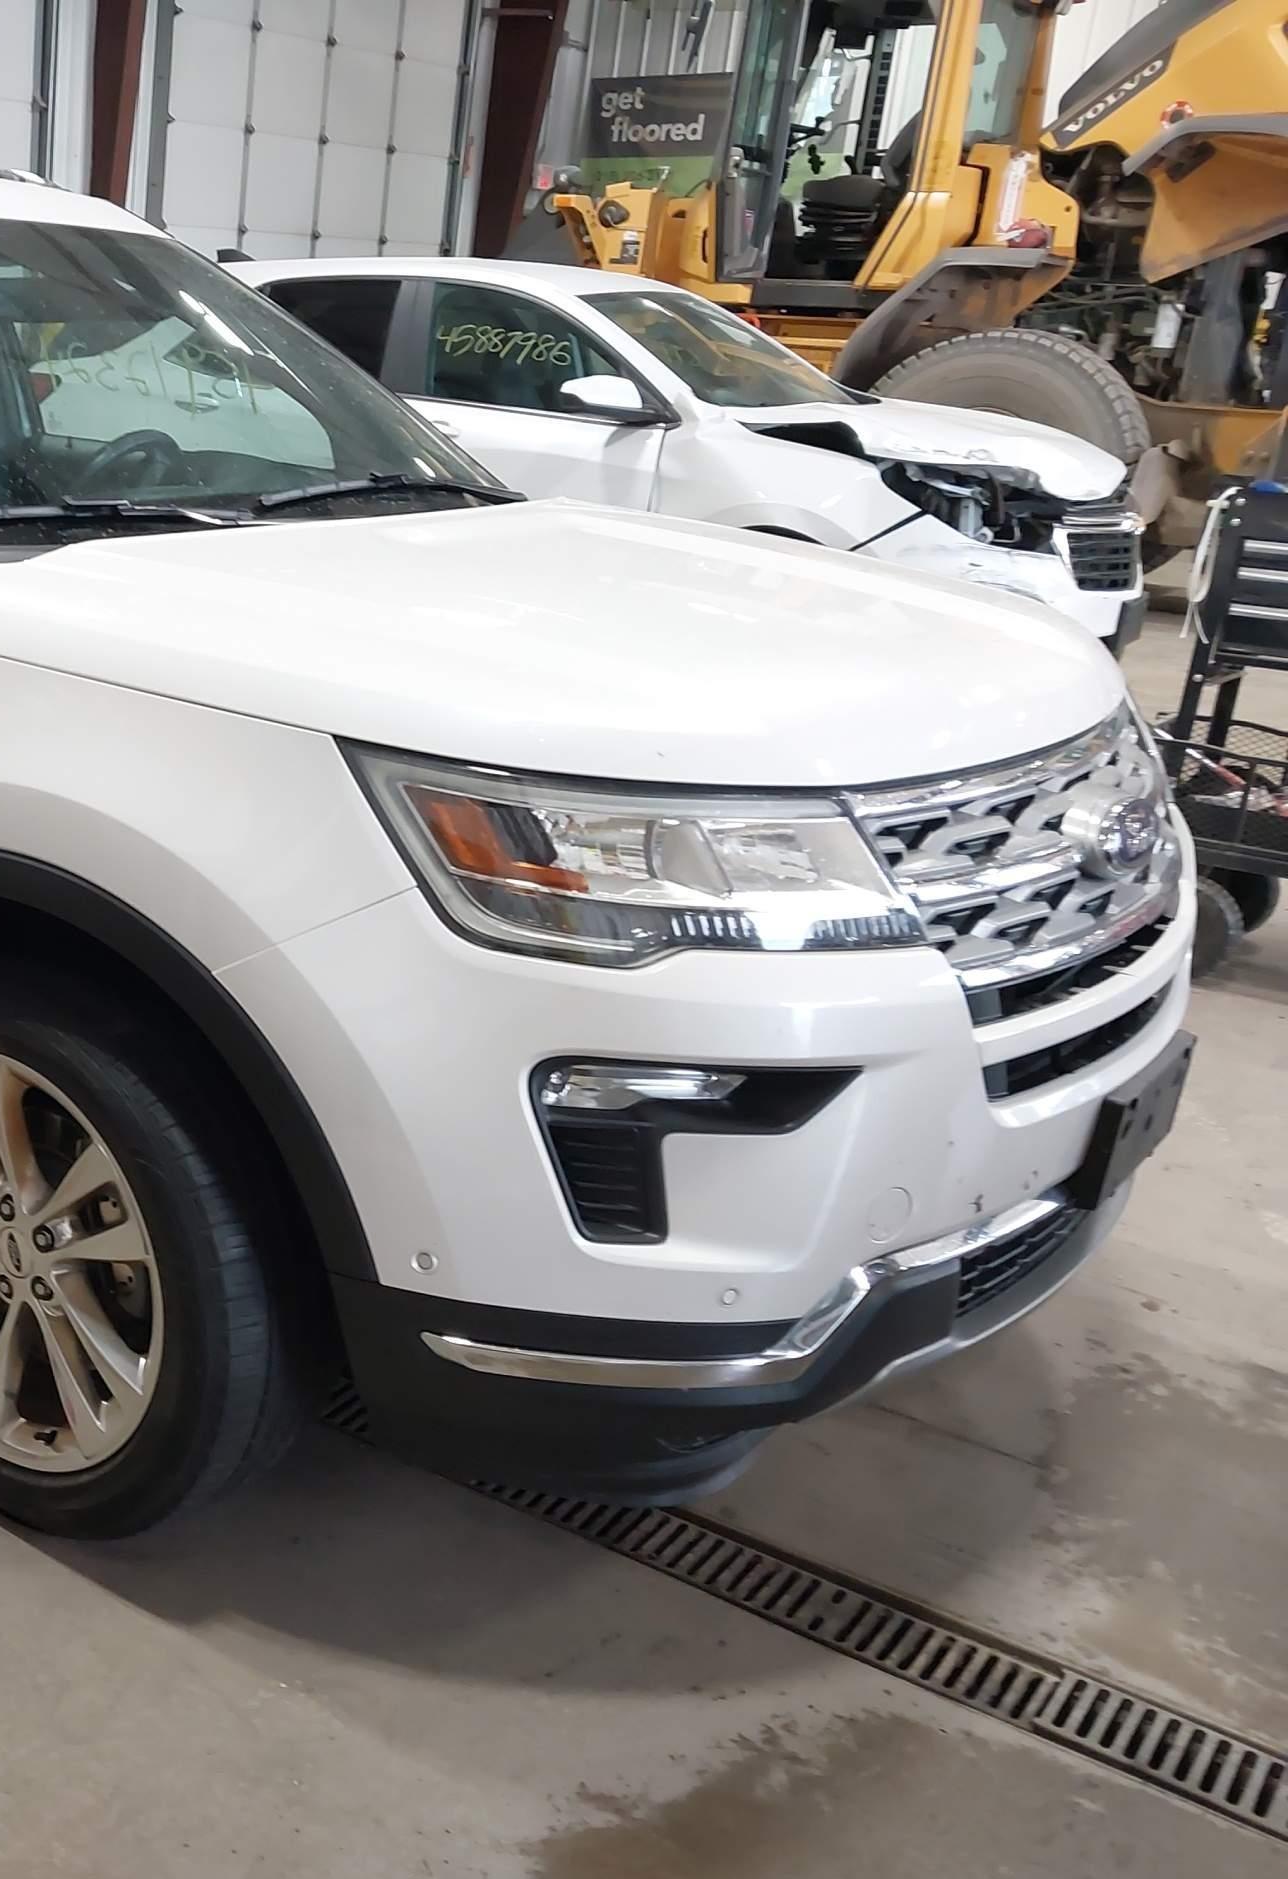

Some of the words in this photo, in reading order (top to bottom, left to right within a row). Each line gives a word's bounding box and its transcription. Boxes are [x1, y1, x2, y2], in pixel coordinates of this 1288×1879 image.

[600, 86, 645, 118] get
[1062, 60, 1164, 132] VOLVO
[611, 113, 705, 142] floored
[436, 324, 571, 365] 45887986
